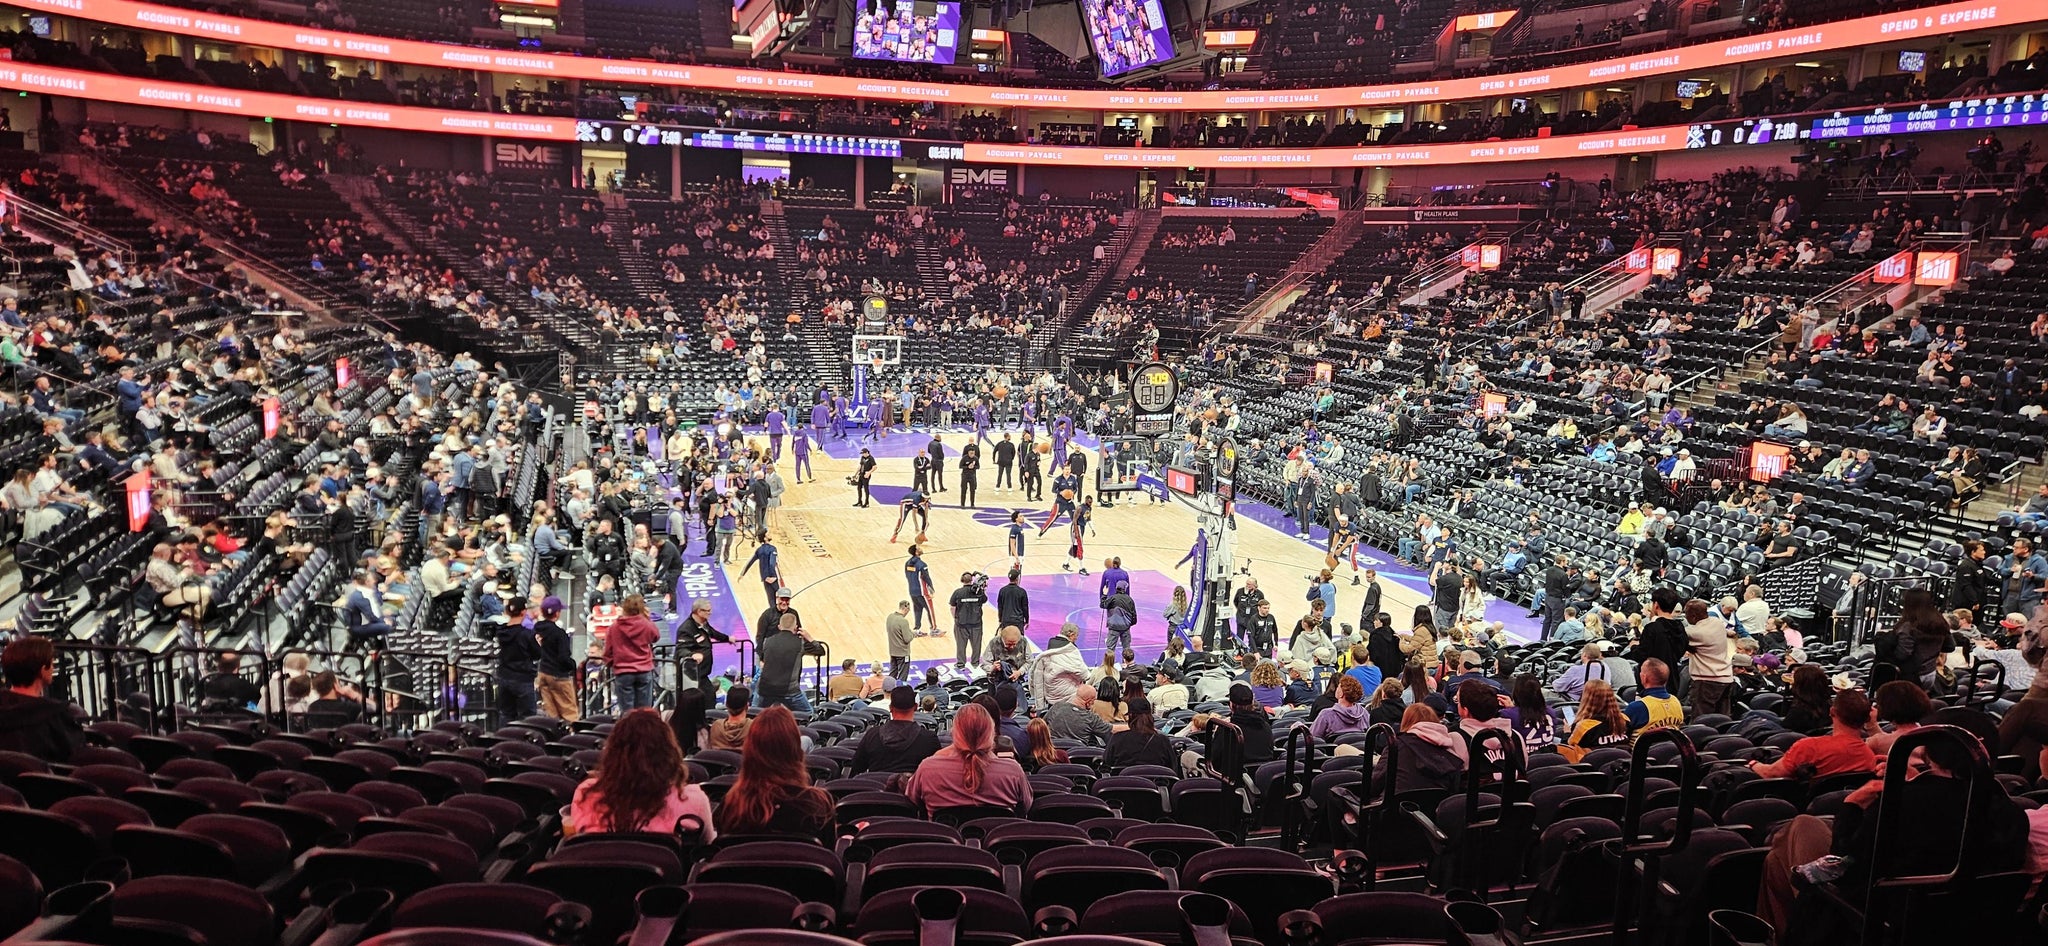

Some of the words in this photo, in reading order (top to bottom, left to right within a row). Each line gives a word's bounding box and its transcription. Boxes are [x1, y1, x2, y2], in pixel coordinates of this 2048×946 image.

[136, 11, 189, 28] ACCOUNTS
[195, 20, 240, 35] PAYABLE
[1478, 13, 1494, 28] bill
[1881, 19, 1918, 33] SPEND
[1940, 7, 1996, 25] EXPENSE
[296, 34, 328, 46] SPEND
[347, 41, 390, 54] EXPENSE
[1220, 32, 1235, 44] bill
[1725, 41, 1772, 56] ACCOUNTS
[1778, 33, 1822, 48] PAYABLE
[443, 52, 490, 63] ACCOUNTS
[496, 57, 554, 69] RECEIVABLE
[1589, 64, 1625, 77] ACCOUNTS
[1630, 56, 1679, 71] RECEIVABLE
[602, 65, 647, 76] ACCOUNTS
[652, 68, 690, 79] PAYABLE
[22, 74, 85, 90] RECEIVABLE
[736, 75, 762, 84] SPEND
[778, 78, 814, 88] EXPENSE
[1480, 80, 1505, 90] SPEND
[1519, 74, 1550, 86] EXPENSE
[139, 88, 191, 103] ACCOUNTS
[197, 94, 241, 108] PAYABLE
[857, 84, 896, 93] ACCOUNTS
[902, 87, 949, 97] RECEIVABLE
[991, 92, 1028, 101] ACCOUNTS
[1033, 93, 1067, 102] PAYABLE
[1361, 89, 1400, 99] ACCOUNTS
[1405, 87, 1439, 97] PAYABLE
[1110, 96, 1134, 104] SPEND
[1149, 96, 1182, 104] EXPENSE
[1270, 94, 1319, 103] RECEIVABLE
[297, 104, 328, 117] SPEND
[347, 109, 390, 121] EXPENSE
[1950, 119, 1956, 128] 0
[1967, 118, 1974, 126] 0
[1985, 116, 1992, 125] 0
[2004, 115, 2010, 124] 0
[2022, 114, 2029, 123] 0
[2042, 112, 2048, 121] 0
[442, 118, 489, 128] ACCOUNTS
[495, 121, 552, 133] RECEIVABLE
[1774, 122, 1798, 141] 7:09
[601, 127, 612, 141] 0
[624, 128, 634, 142] 0
[1711, 129, 1722, 145] 0
[1734, 127, 1745, 143] 0
[1578, 141, 1614, 150] ACCOUNTS
[1618, 135, 1666, 147] RECEIVABLE
[496, 144, 562, 163] SME
[951, 148, 963, 160] PM
[986, 150, 1024, 158] ACCOUNTS
[1028, 151, 1062, 160] PAYABLE
[1142, 154, 1176, 162] EXPENSE
[1262, 154, 1311, 162] RECEIVABLE
[1353, 152, 1392, 160] ACCOUNTS
[1396, 151, 1430, 160] PAYABLE
[1471, 148, 1493, 156] SPEND
[1508, 146, 1539, 154] EXPENSE
[951, 168, 1006, 184] SME
[1922, 259, 1950, 279] bill
[1146, 373, 1168, 385] 7:09
[682, 563, 718, 590] PACS
[1187, 581, 1200, 622] AMERICA
